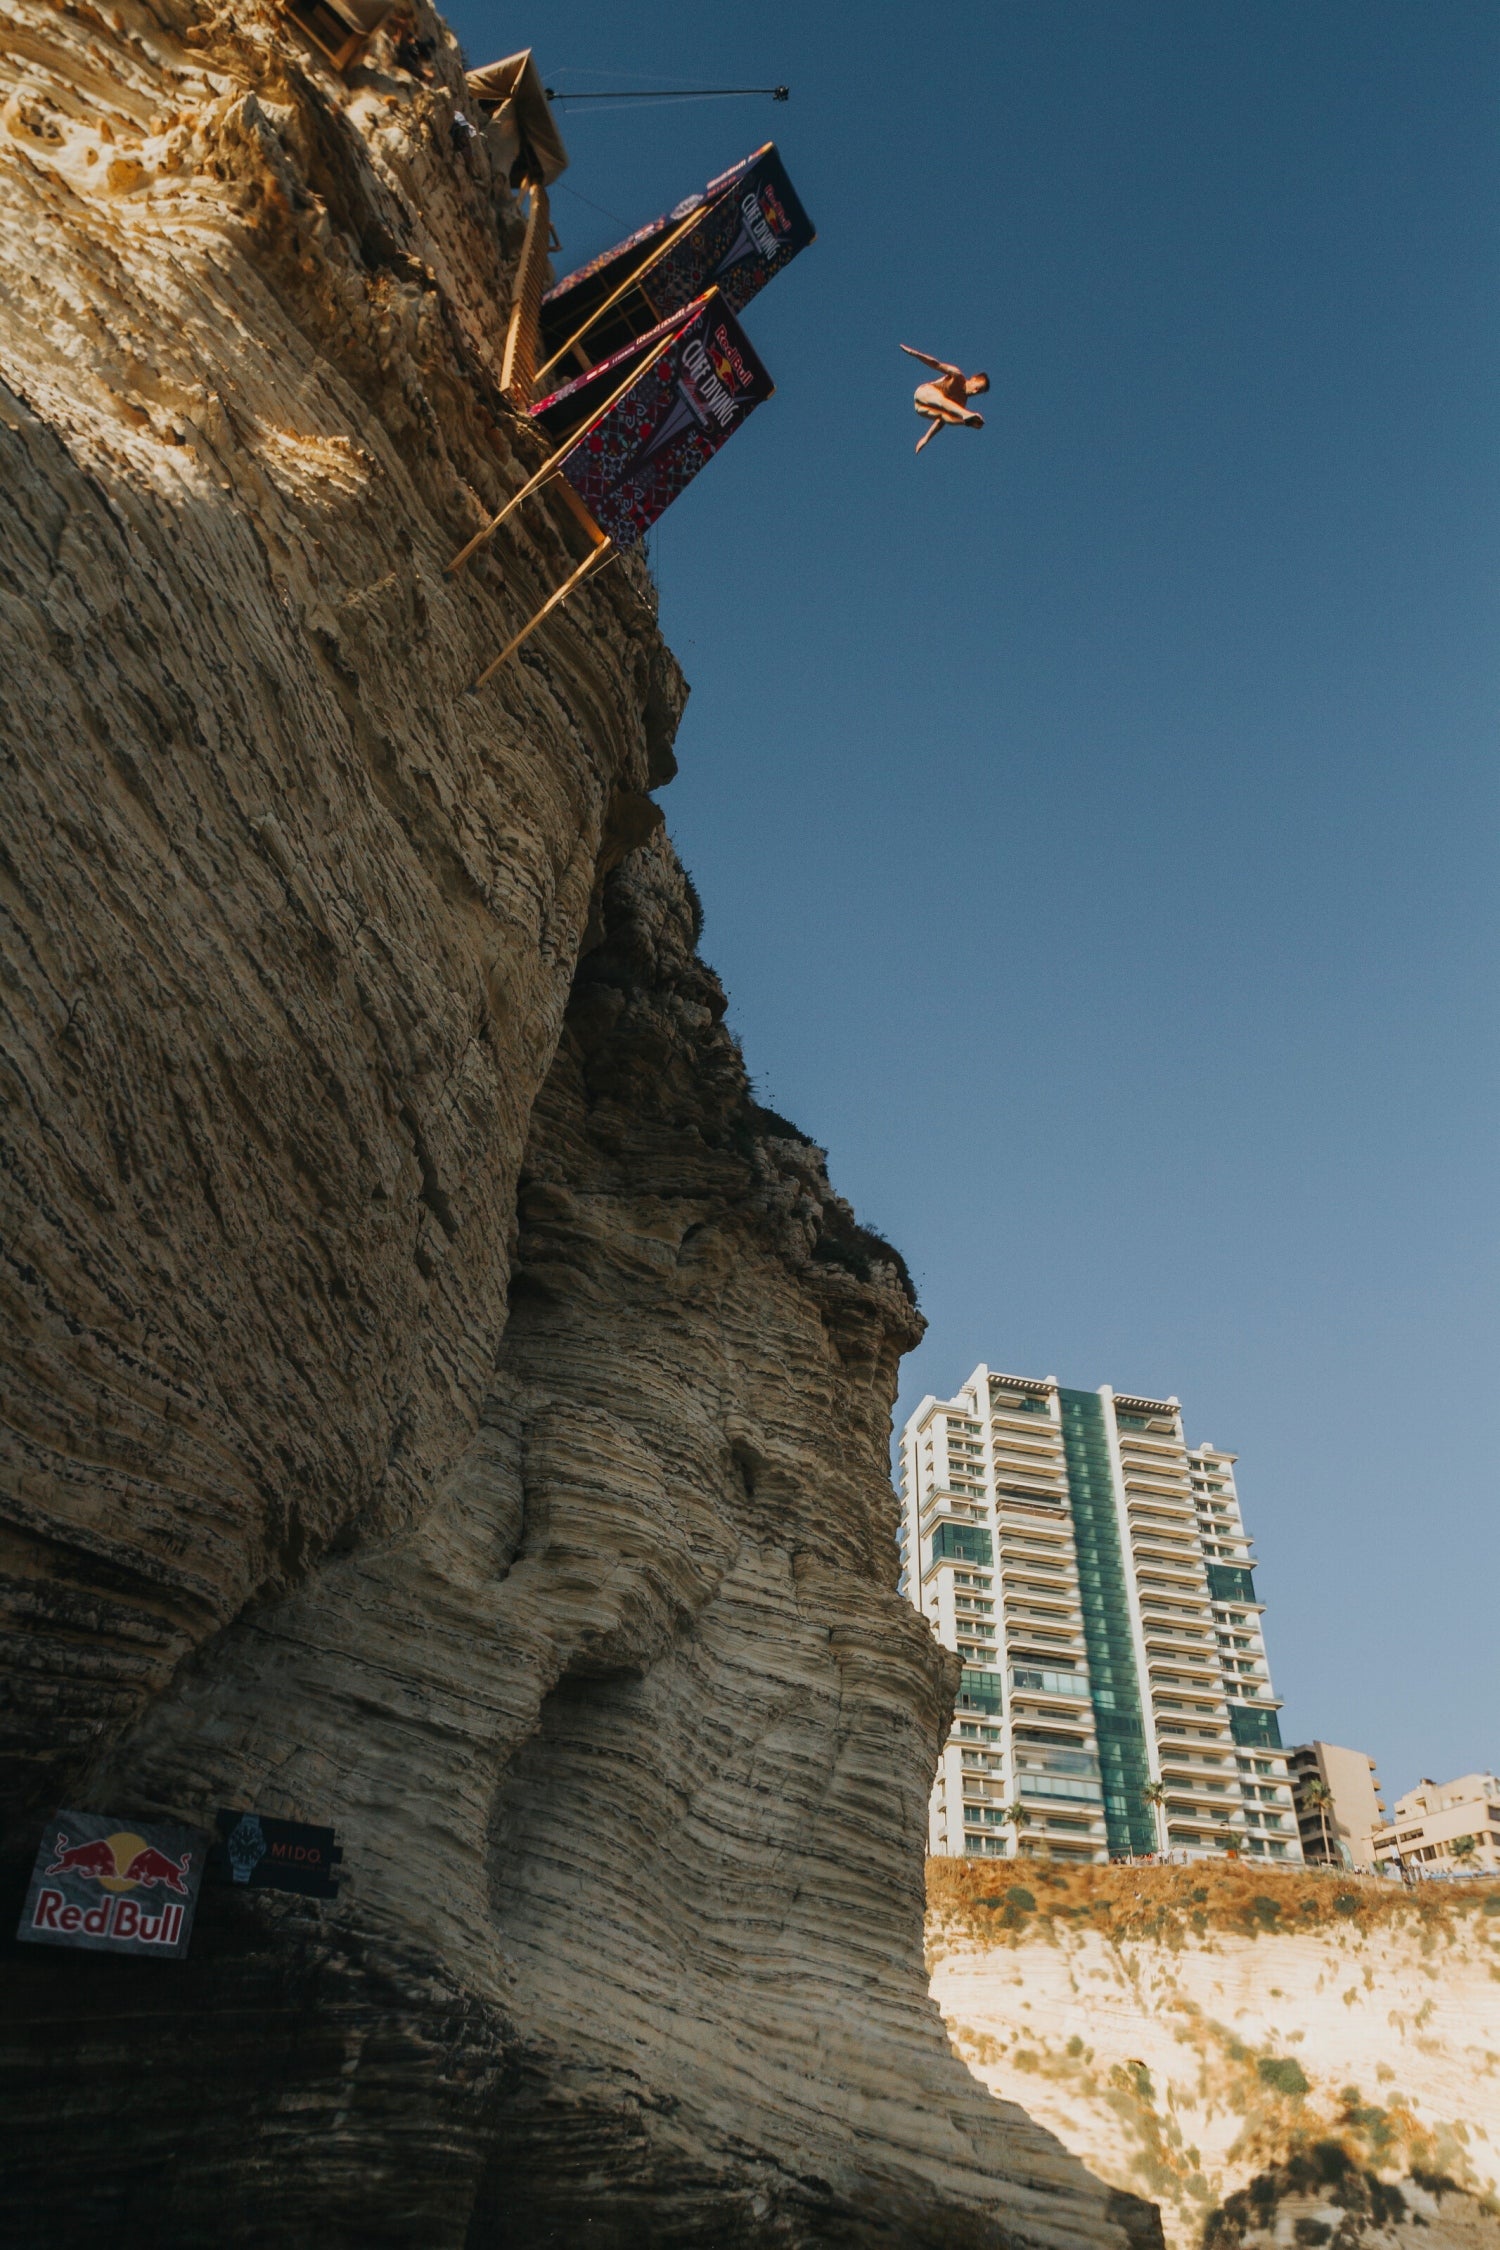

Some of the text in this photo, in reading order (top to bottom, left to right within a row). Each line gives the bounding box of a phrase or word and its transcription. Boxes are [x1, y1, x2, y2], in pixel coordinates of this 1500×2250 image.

[741, 193, 781, 260] CLIFF DIVING
[682, 339, 739, 428] CLIFF DIVING
[271, 1842, 321, 1864] MIDO
